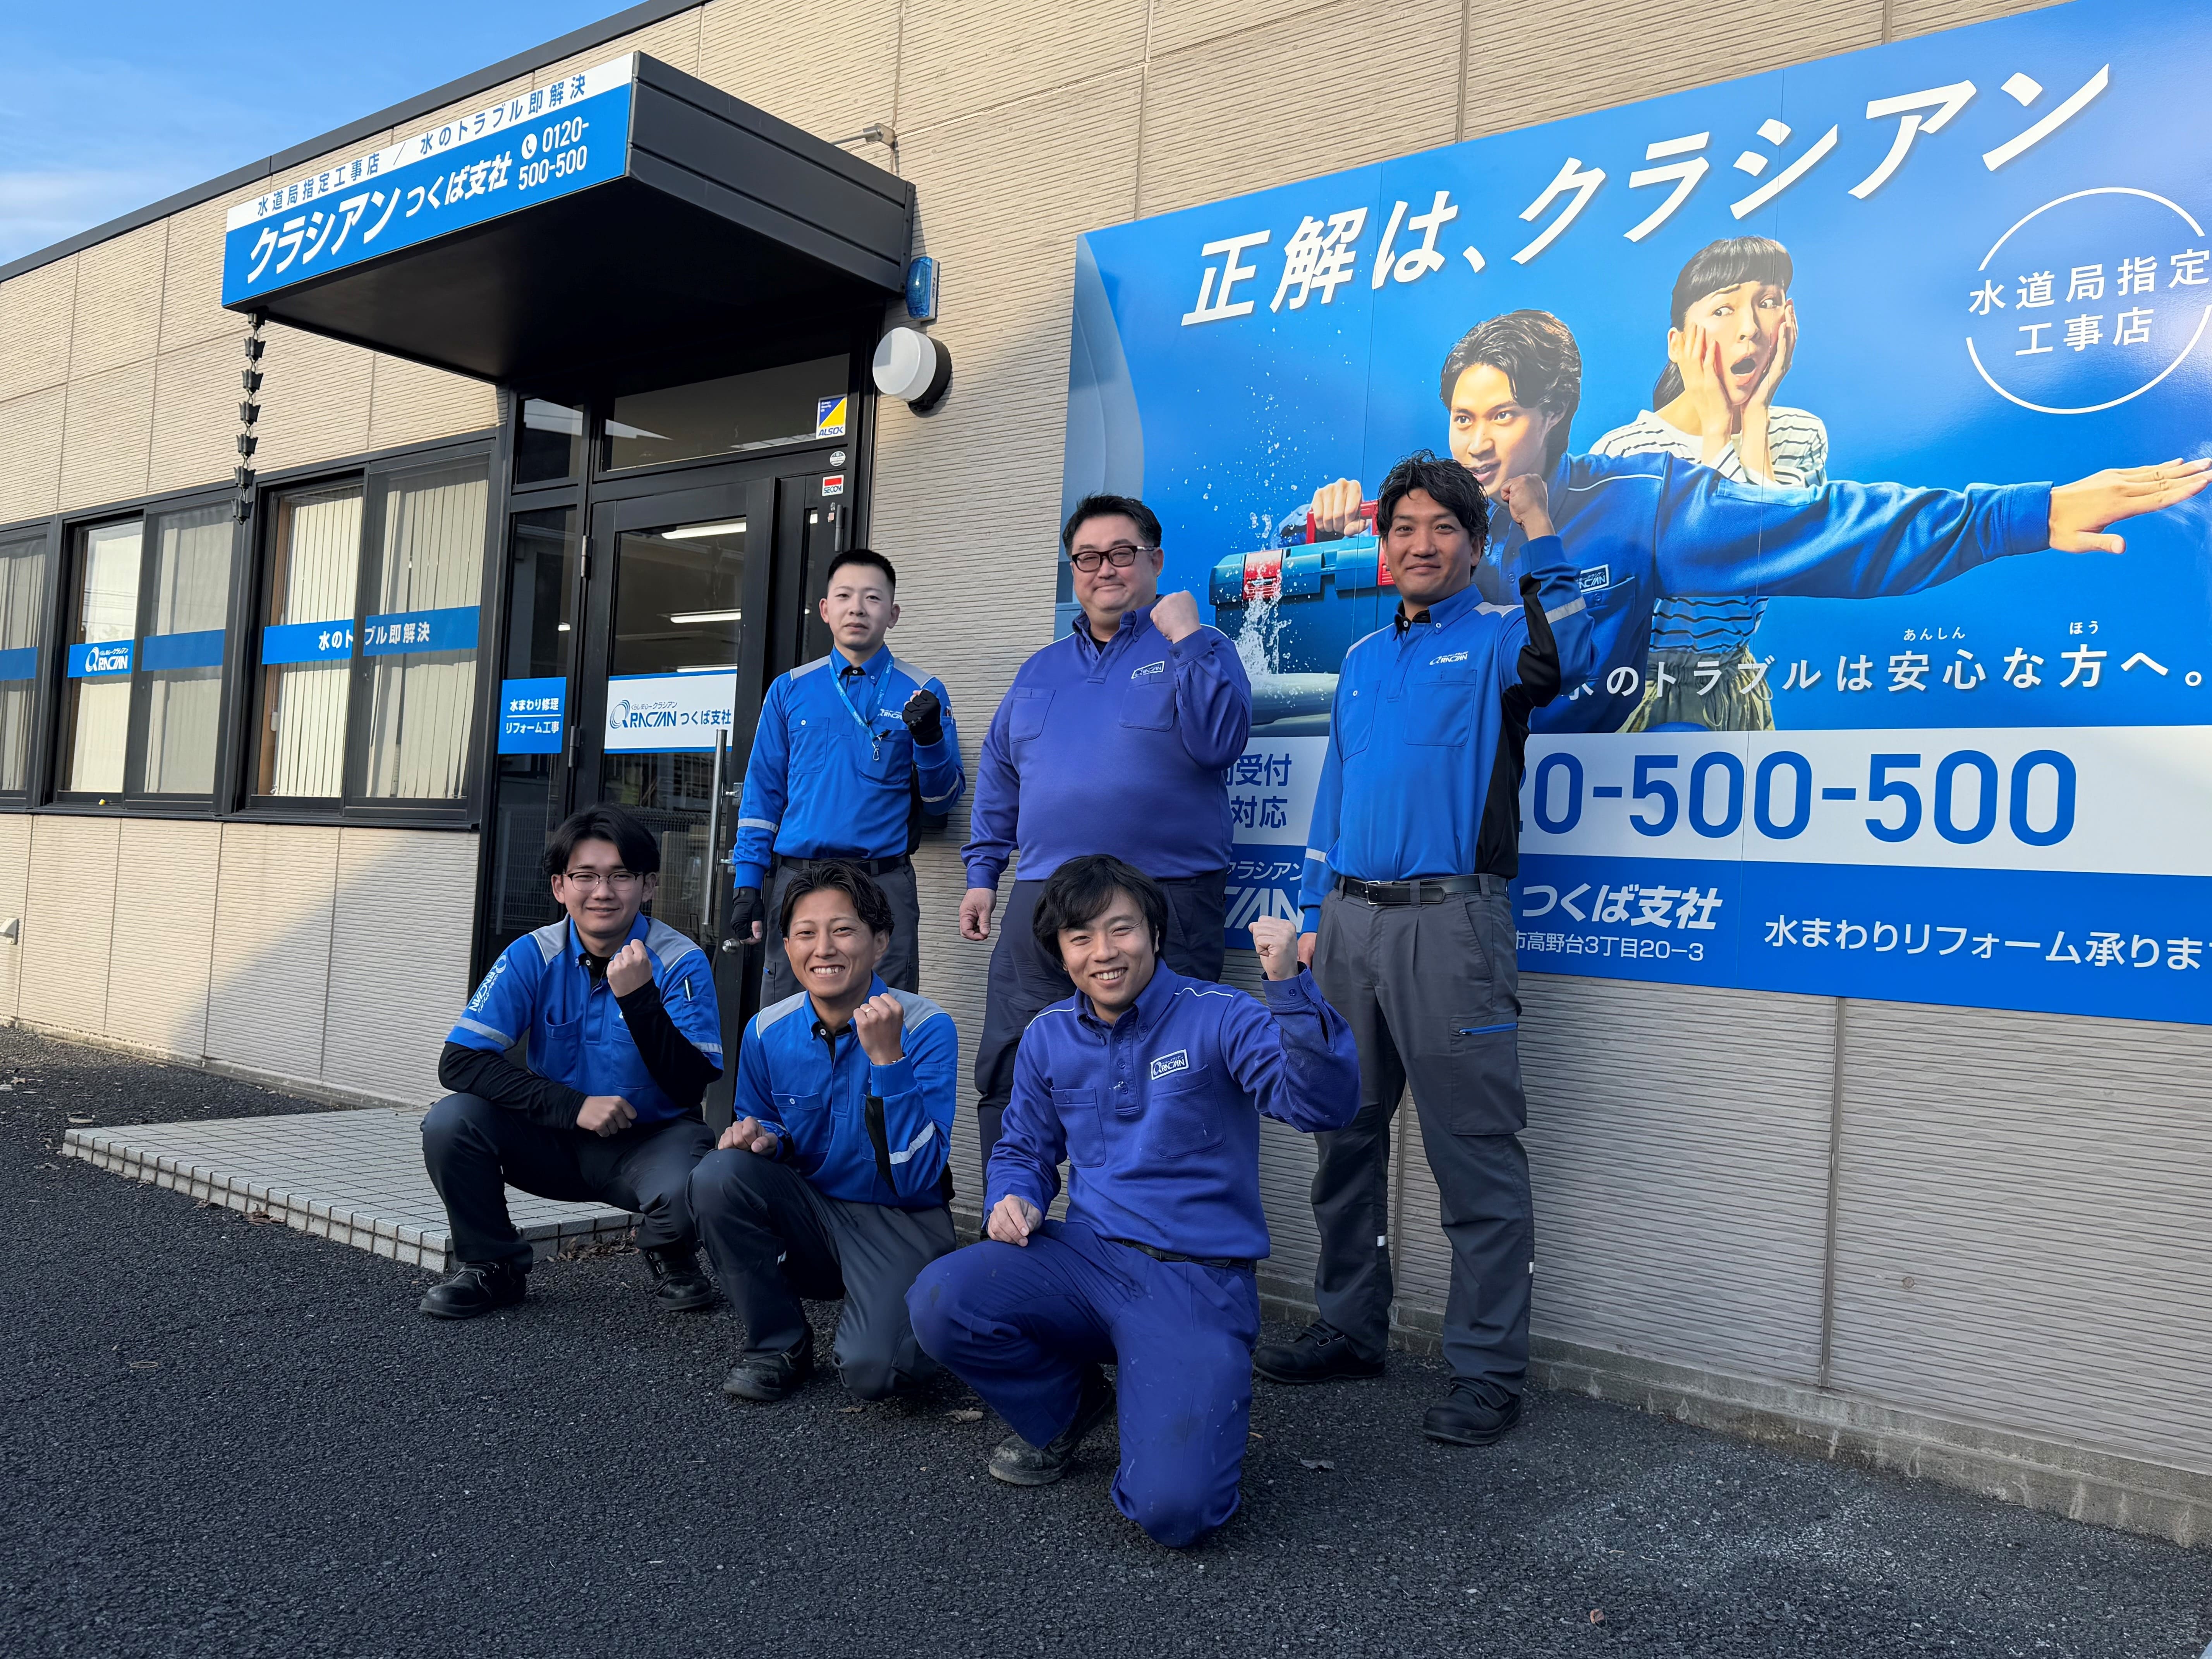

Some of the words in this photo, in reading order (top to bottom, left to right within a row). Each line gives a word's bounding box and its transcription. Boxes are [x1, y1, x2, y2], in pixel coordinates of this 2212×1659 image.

[258, 154, 380, 217] 水道局指定工事店
[420, 74, 586, 155] 水のトラブル即解決
[542, 116, 589, 152] 0120-
[519, 145, 588, 191] 500-500
[1182, 63, 2110, 327] 正解は、クラシアン
[247, 187, 401, 284] クラシアン
[405, 151, 512, 218] つくば支社
[1968, 248, 2210, 316] 水道局指定
[2015, 306, 2154, 356] 工事店
[819, 426, 843, 436] ALSOK
[824, 485, 842, 493] SECOM
[1903, 627, 1966, 641] あんしん
[2069, 620, 2100, 635] ほう
[510, 698, 559, 712] 水まわり修理
[680, 709, 732, 725] つくば支社
[506, 721, 560, 734] リフォーム工事
[1231, 795, 1288, 828] 対応
[1519, 749, 2076, 847] 0-500-500
[1522, 883, 1723, 930] つくば支社
[1764, 915, 2212, 970] 水まわりリフォーム承りま
